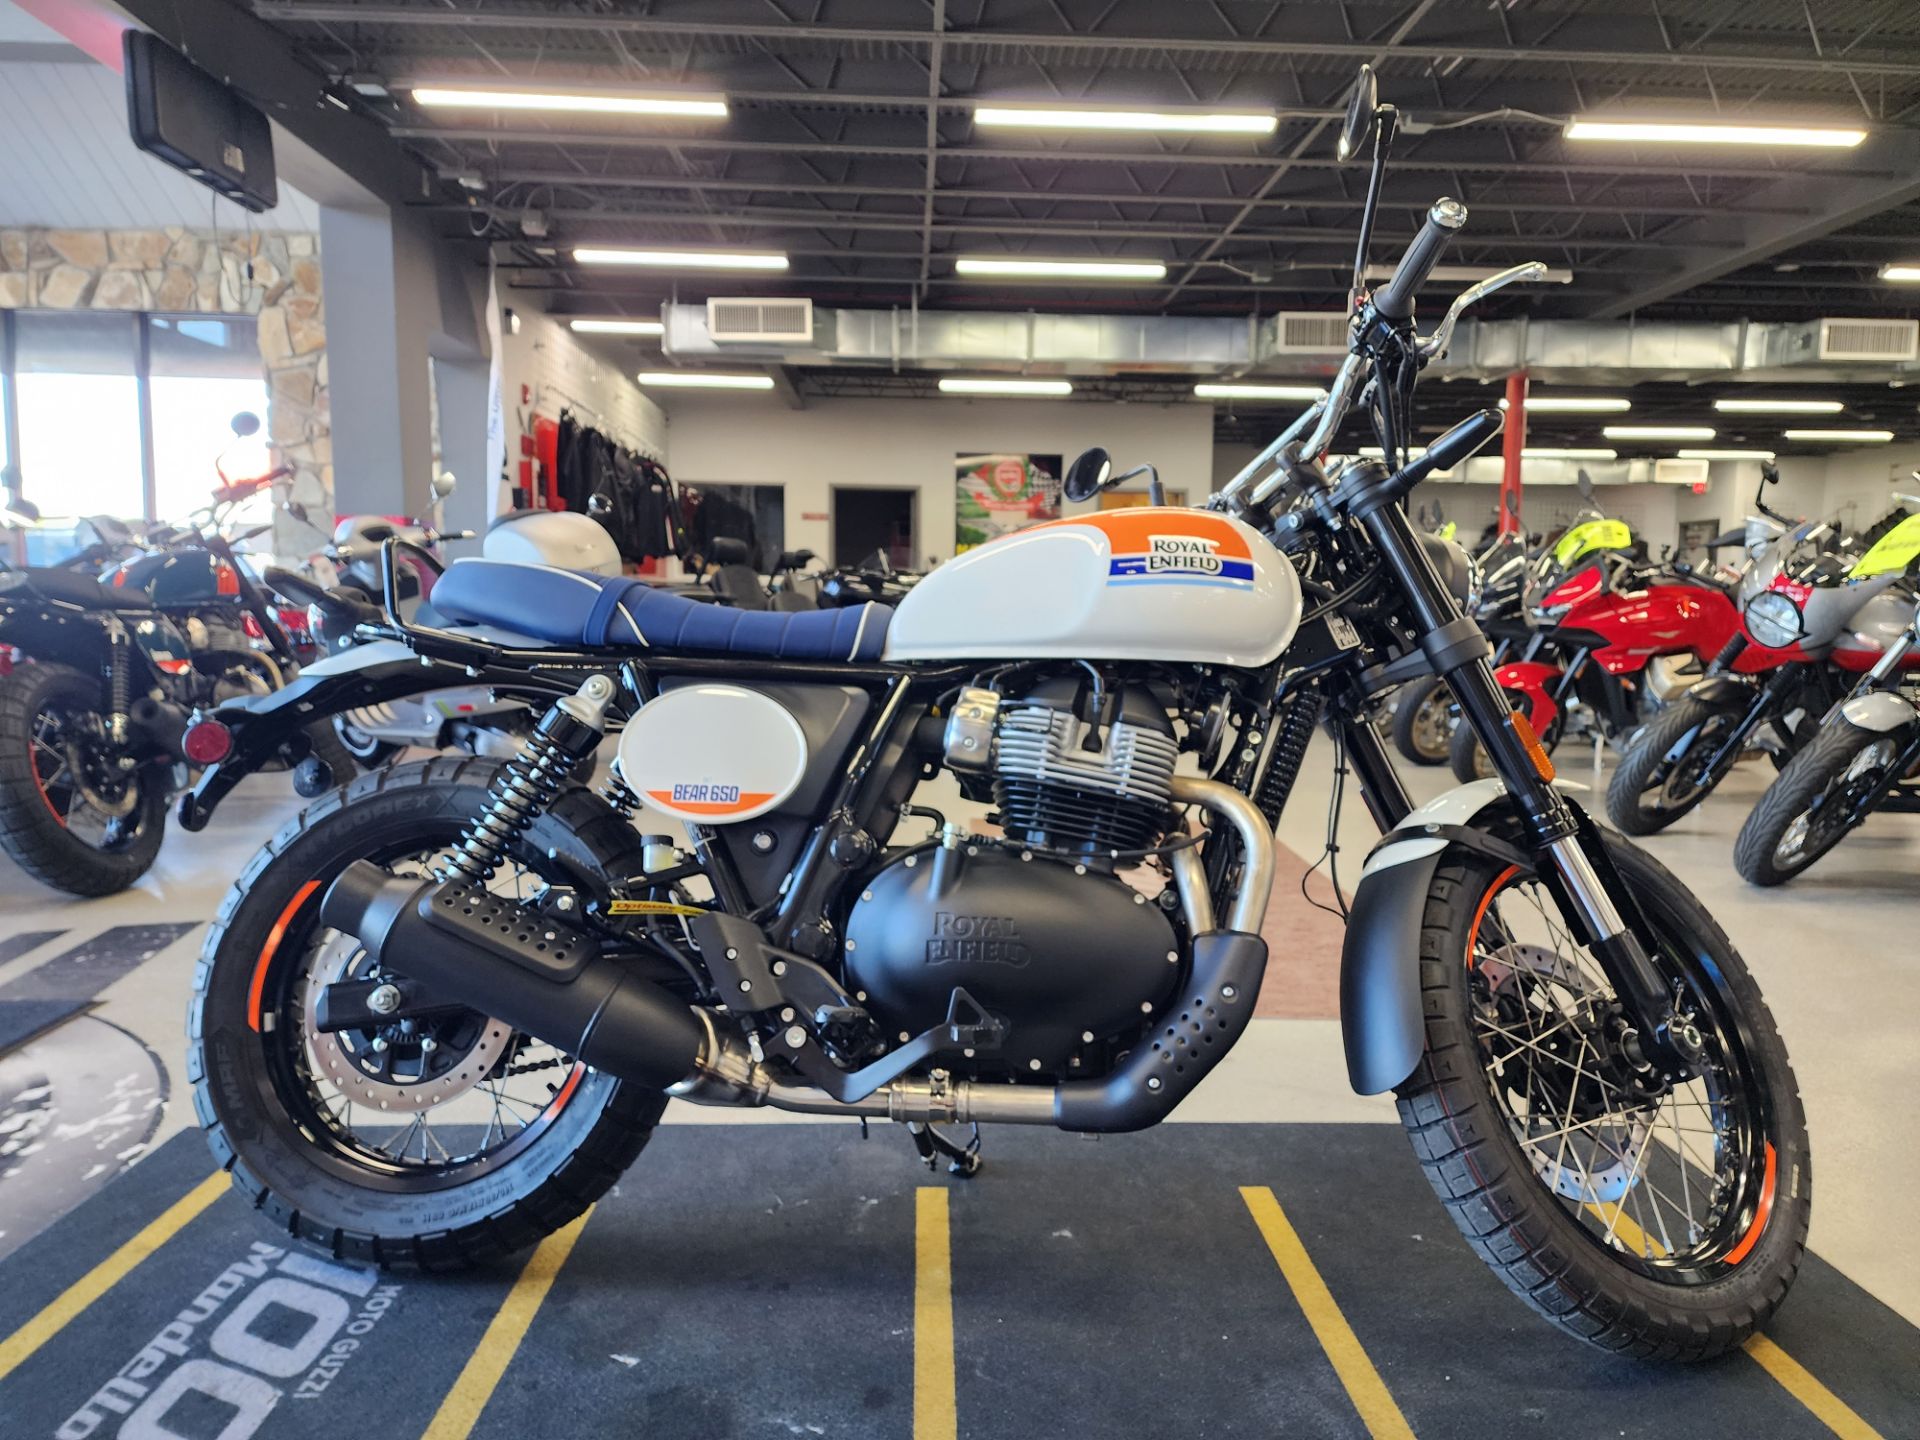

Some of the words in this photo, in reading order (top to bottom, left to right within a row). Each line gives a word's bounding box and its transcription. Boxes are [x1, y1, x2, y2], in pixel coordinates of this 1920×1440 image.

[1153, 540, 1212, 554] ROYAL
[1149, 556, 1219, 571] ENFIELD
[673, 784, 709, 801] BEAR
[710, 785, 739, 802] 650
[934, 912, 1020, 939] ROYAL
[925, 939, 1032, 969] ENFIELD
[347, 1285, 402, 1336] MOTO
[55, 1241, 287, 1440] Mandello
[293, 1338, 361, 1400] GUZZI
